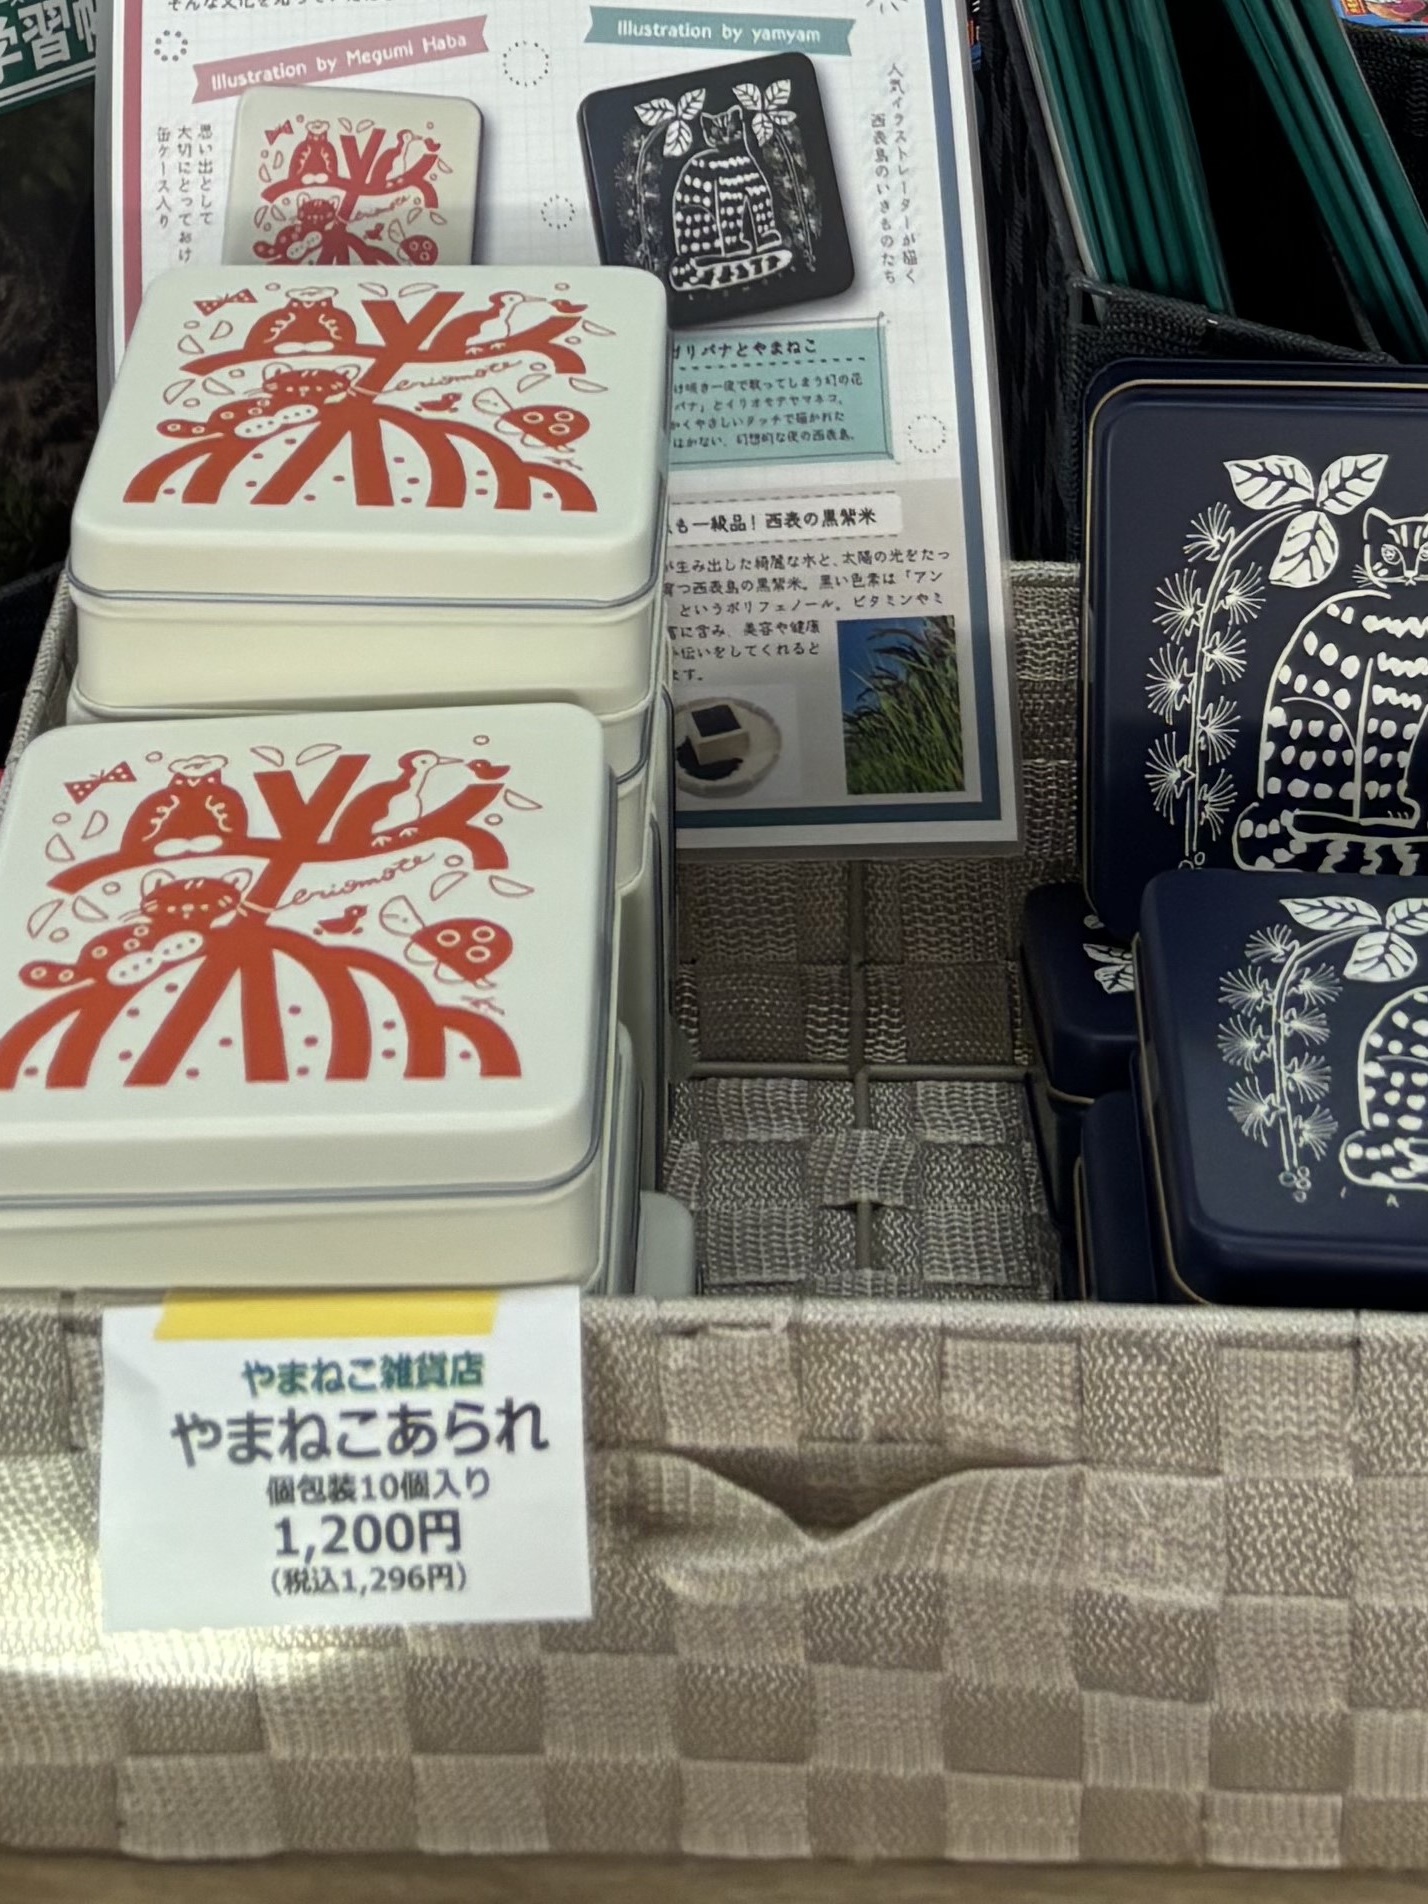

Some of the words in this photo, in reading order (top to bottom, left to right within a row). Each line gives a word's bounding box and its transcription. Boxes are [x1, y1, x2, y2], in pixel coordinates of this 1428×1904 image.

[616, 19, 715, 41] Illustration
[721, 22, 743, 44] by
[750, 24, 822, 46] yamyam
[210, 59, 309, 93] Illustration
[316, 54, 339, 79] by
[345, 40, 415, 71] Megumi
[422, 30, 468, 56] Haba
[241, 1350, 485, 1398] やまねこ雑貨店
[172, 1398, 550, 1468] やまねこあられ
[266, 1468, 492, 1508] 個包装10個入り
[274, 1509, 462, 1566] 1,200円
[270, 1562, 467, 1596] (税込1,296円)
